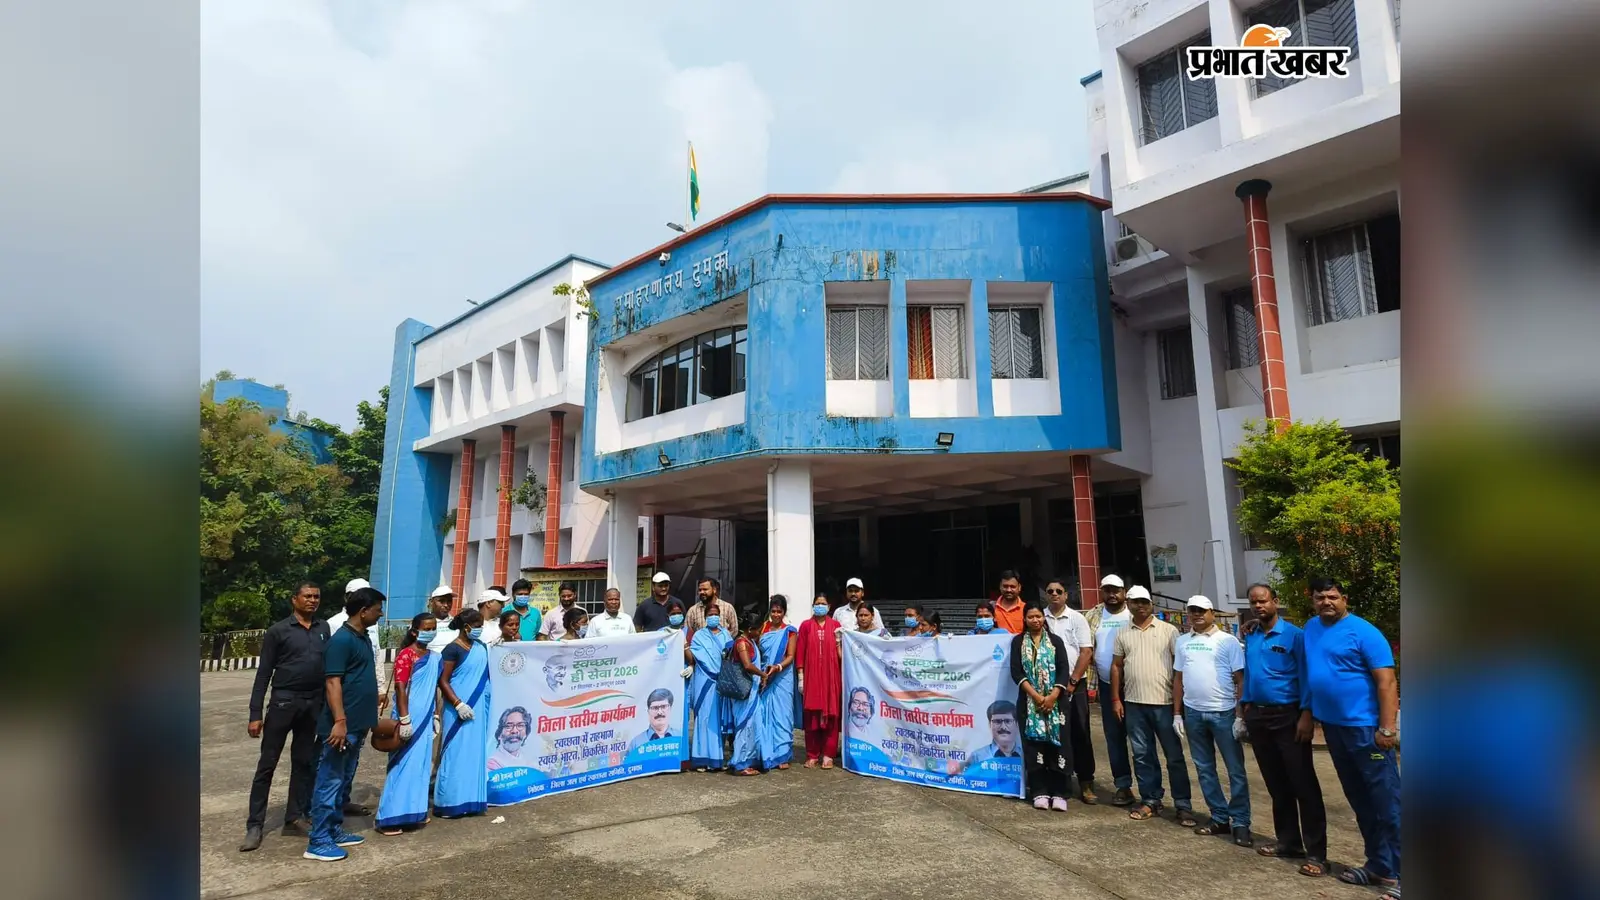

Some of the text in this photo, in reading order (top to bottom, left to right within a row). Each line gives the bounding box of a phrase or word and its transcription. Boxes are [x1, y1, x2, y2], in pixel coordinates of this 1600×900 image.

[692, 249, 729, 288] दुमका
[572, 656, 617, 669] स्वच्छता
[903, 658, 947, 668] स्वच्छता
[570, 665, 639, 682] ही सेवा 2026
[915, 669, 942, 681] सेवा
[943, 671, 971, 681] 2026
[537, 704, 636, 734] जिला स्तरीय कार्यक्रम
[880, 701, 974, 728] जिला स्तरीय कार्यक्रम
[554, 736, 580, 749] स्वच्छता
[590, 729, 614, 743] सहभाग
[538, 741, 626, 766] स्वच्छ भारत, विकसित भारत
[919, 745, 945, 759] विकसित
[949, 750, 966, 760] भारत
